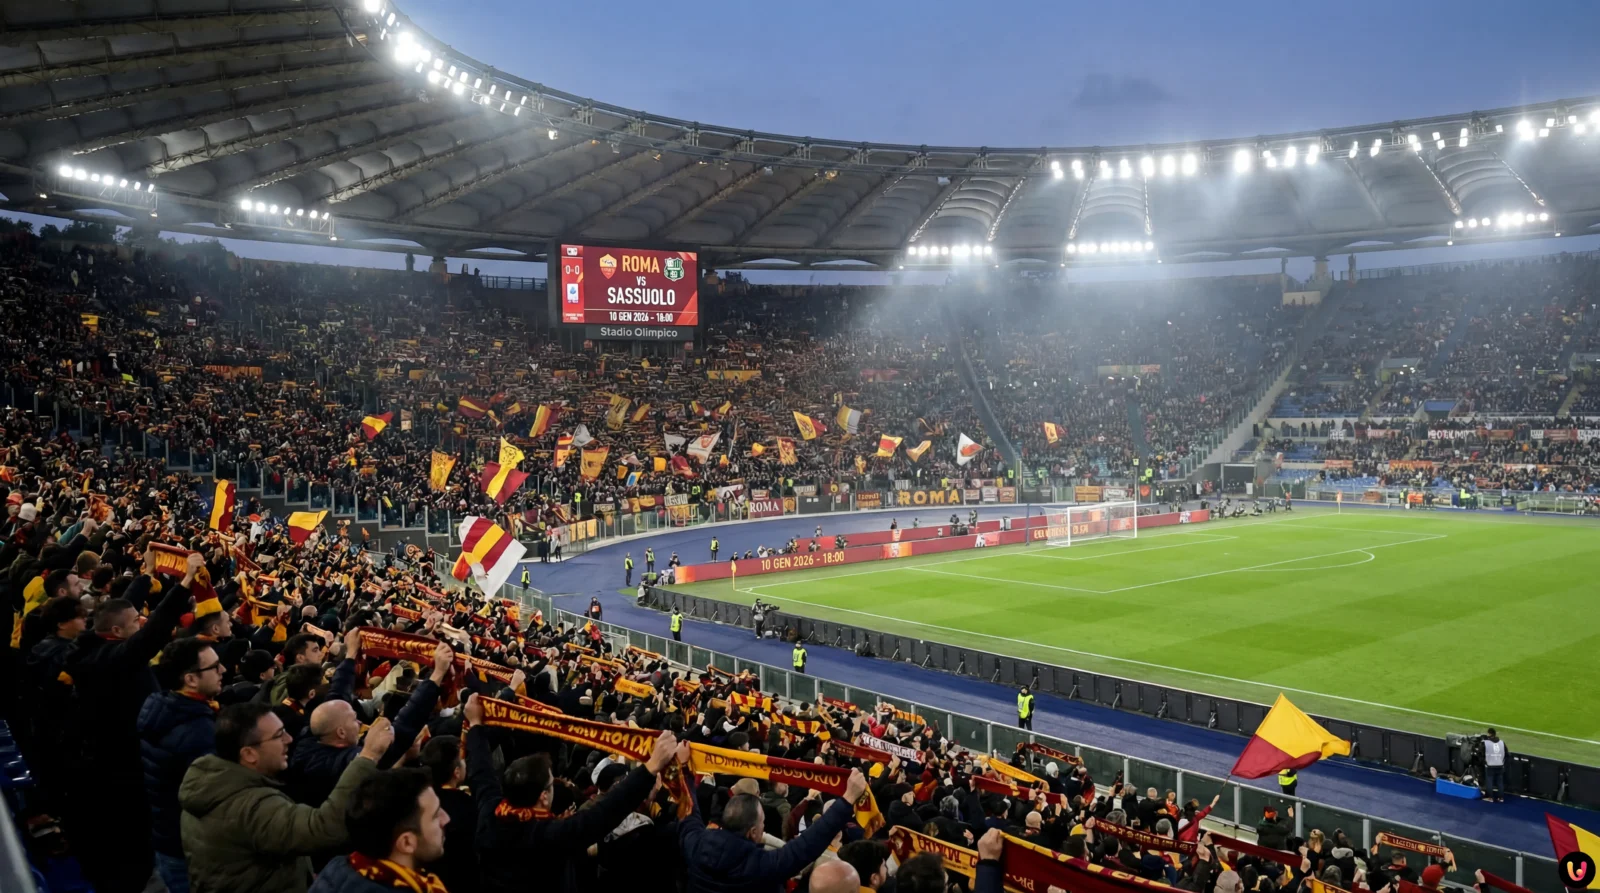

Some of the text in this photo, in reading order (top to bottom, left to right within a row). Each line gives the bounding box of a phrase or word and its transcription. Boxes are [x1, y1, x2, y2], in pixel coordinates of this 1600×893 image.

[622, 255, 660, 273] ROMA
[636, 276, 646, 286] VS
[607, 287, 676, 305] SASSUOLO
[609, 311, 618, 321] 10
[619, 311, 632, 322] GEN
[633, 312, 649, 322] 2026
[657, 312, 673, 322] 18:00
[600, 326, 678, 339] Stadio Olimpico
[898, 489, 961, 505] ROMA
[749, 500, 780, 513] ROMA
[761, 559, 771, 571] 10
[773, 557, 791, 569] GEN
[793, 554, 814, 567] 2026
[823, 551, 845, 564] 18:00
